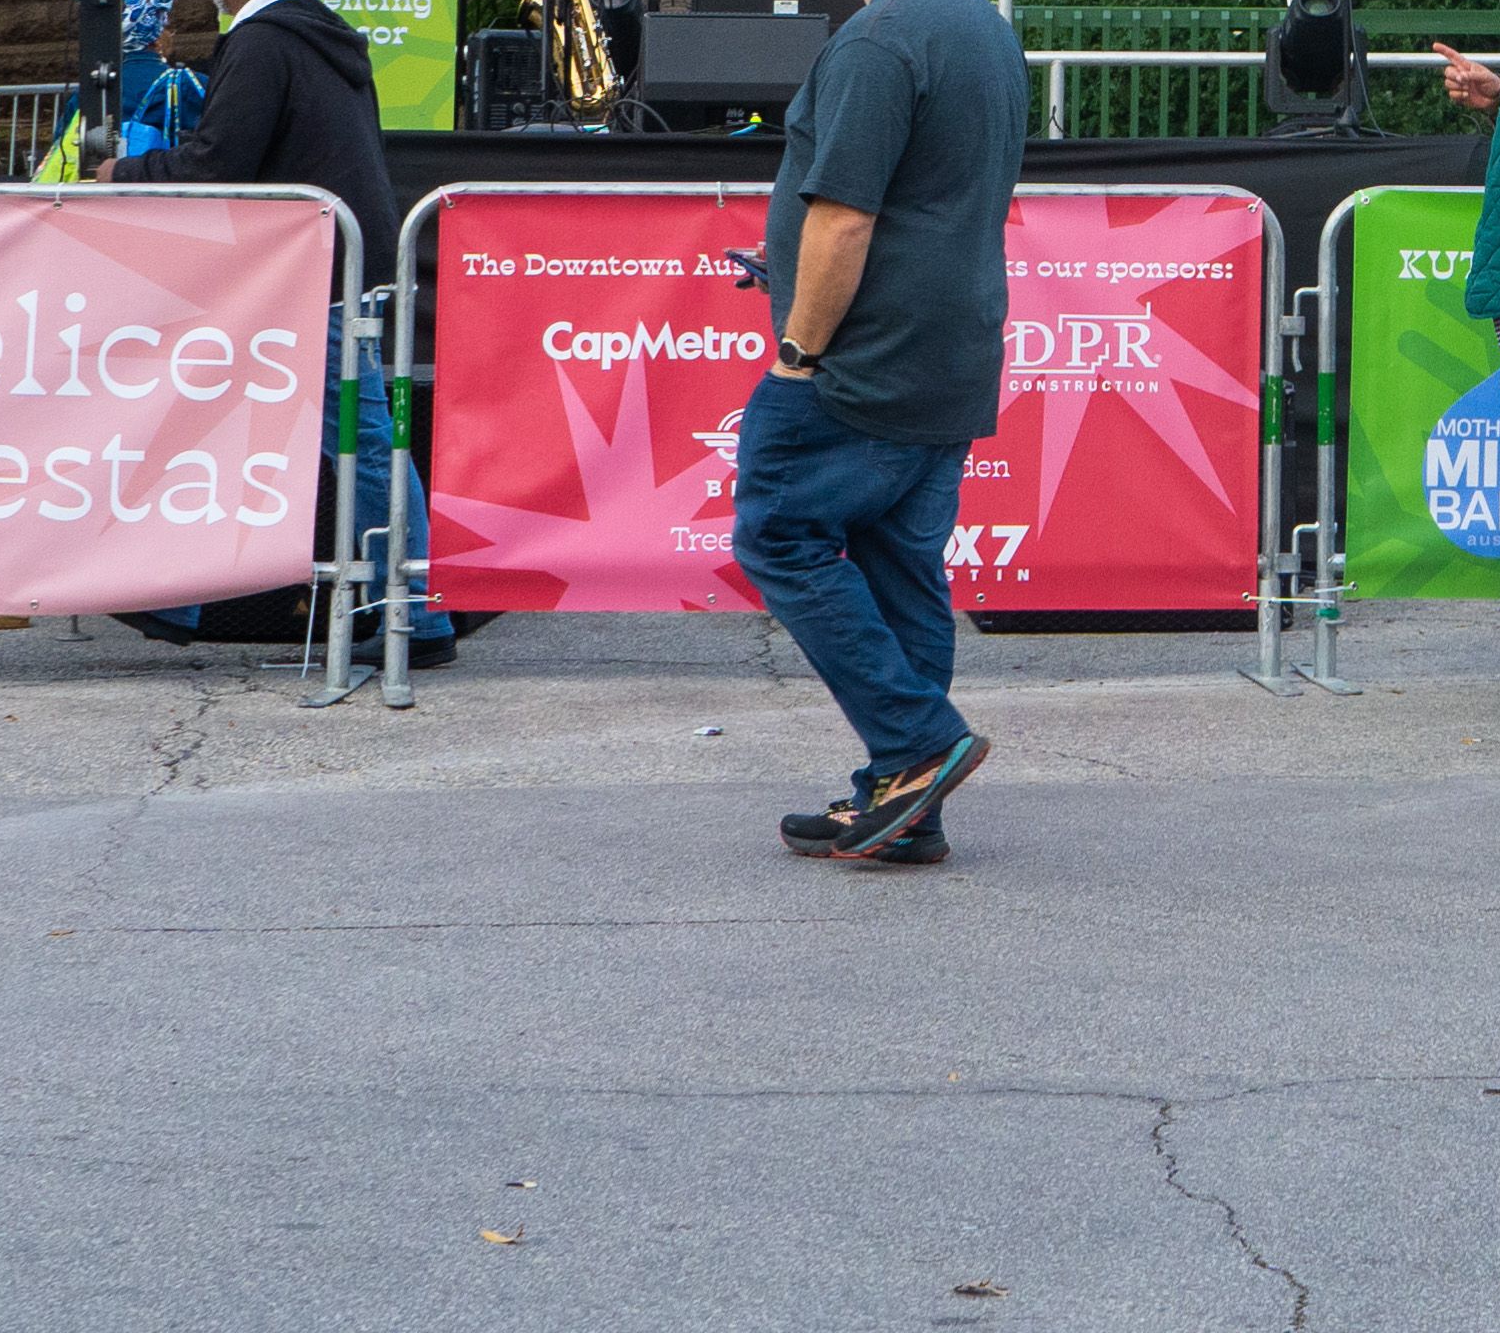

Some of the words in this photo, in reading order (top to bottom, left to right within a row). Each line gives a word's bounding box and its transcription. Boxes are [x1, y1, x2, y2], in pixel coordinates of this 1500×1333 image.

[463, 254, 517, 277] The
[524, 254, 684, 278] Downtown
[692, 254, 747, 276] Aus
[1037, 261, 1087, 277] our
[1095, 260, 1234, 283] sponsors:
[543, 318, 766, 371] CapMetro
[1009, 320, 1160, 369] DPR
[1009, 379, 1160, 393] CONSTRUCTION
[963, 454, 1011, 478] den
[670, 526, 733, 552] Tree
[945, 568, 1030, 582] STIN
